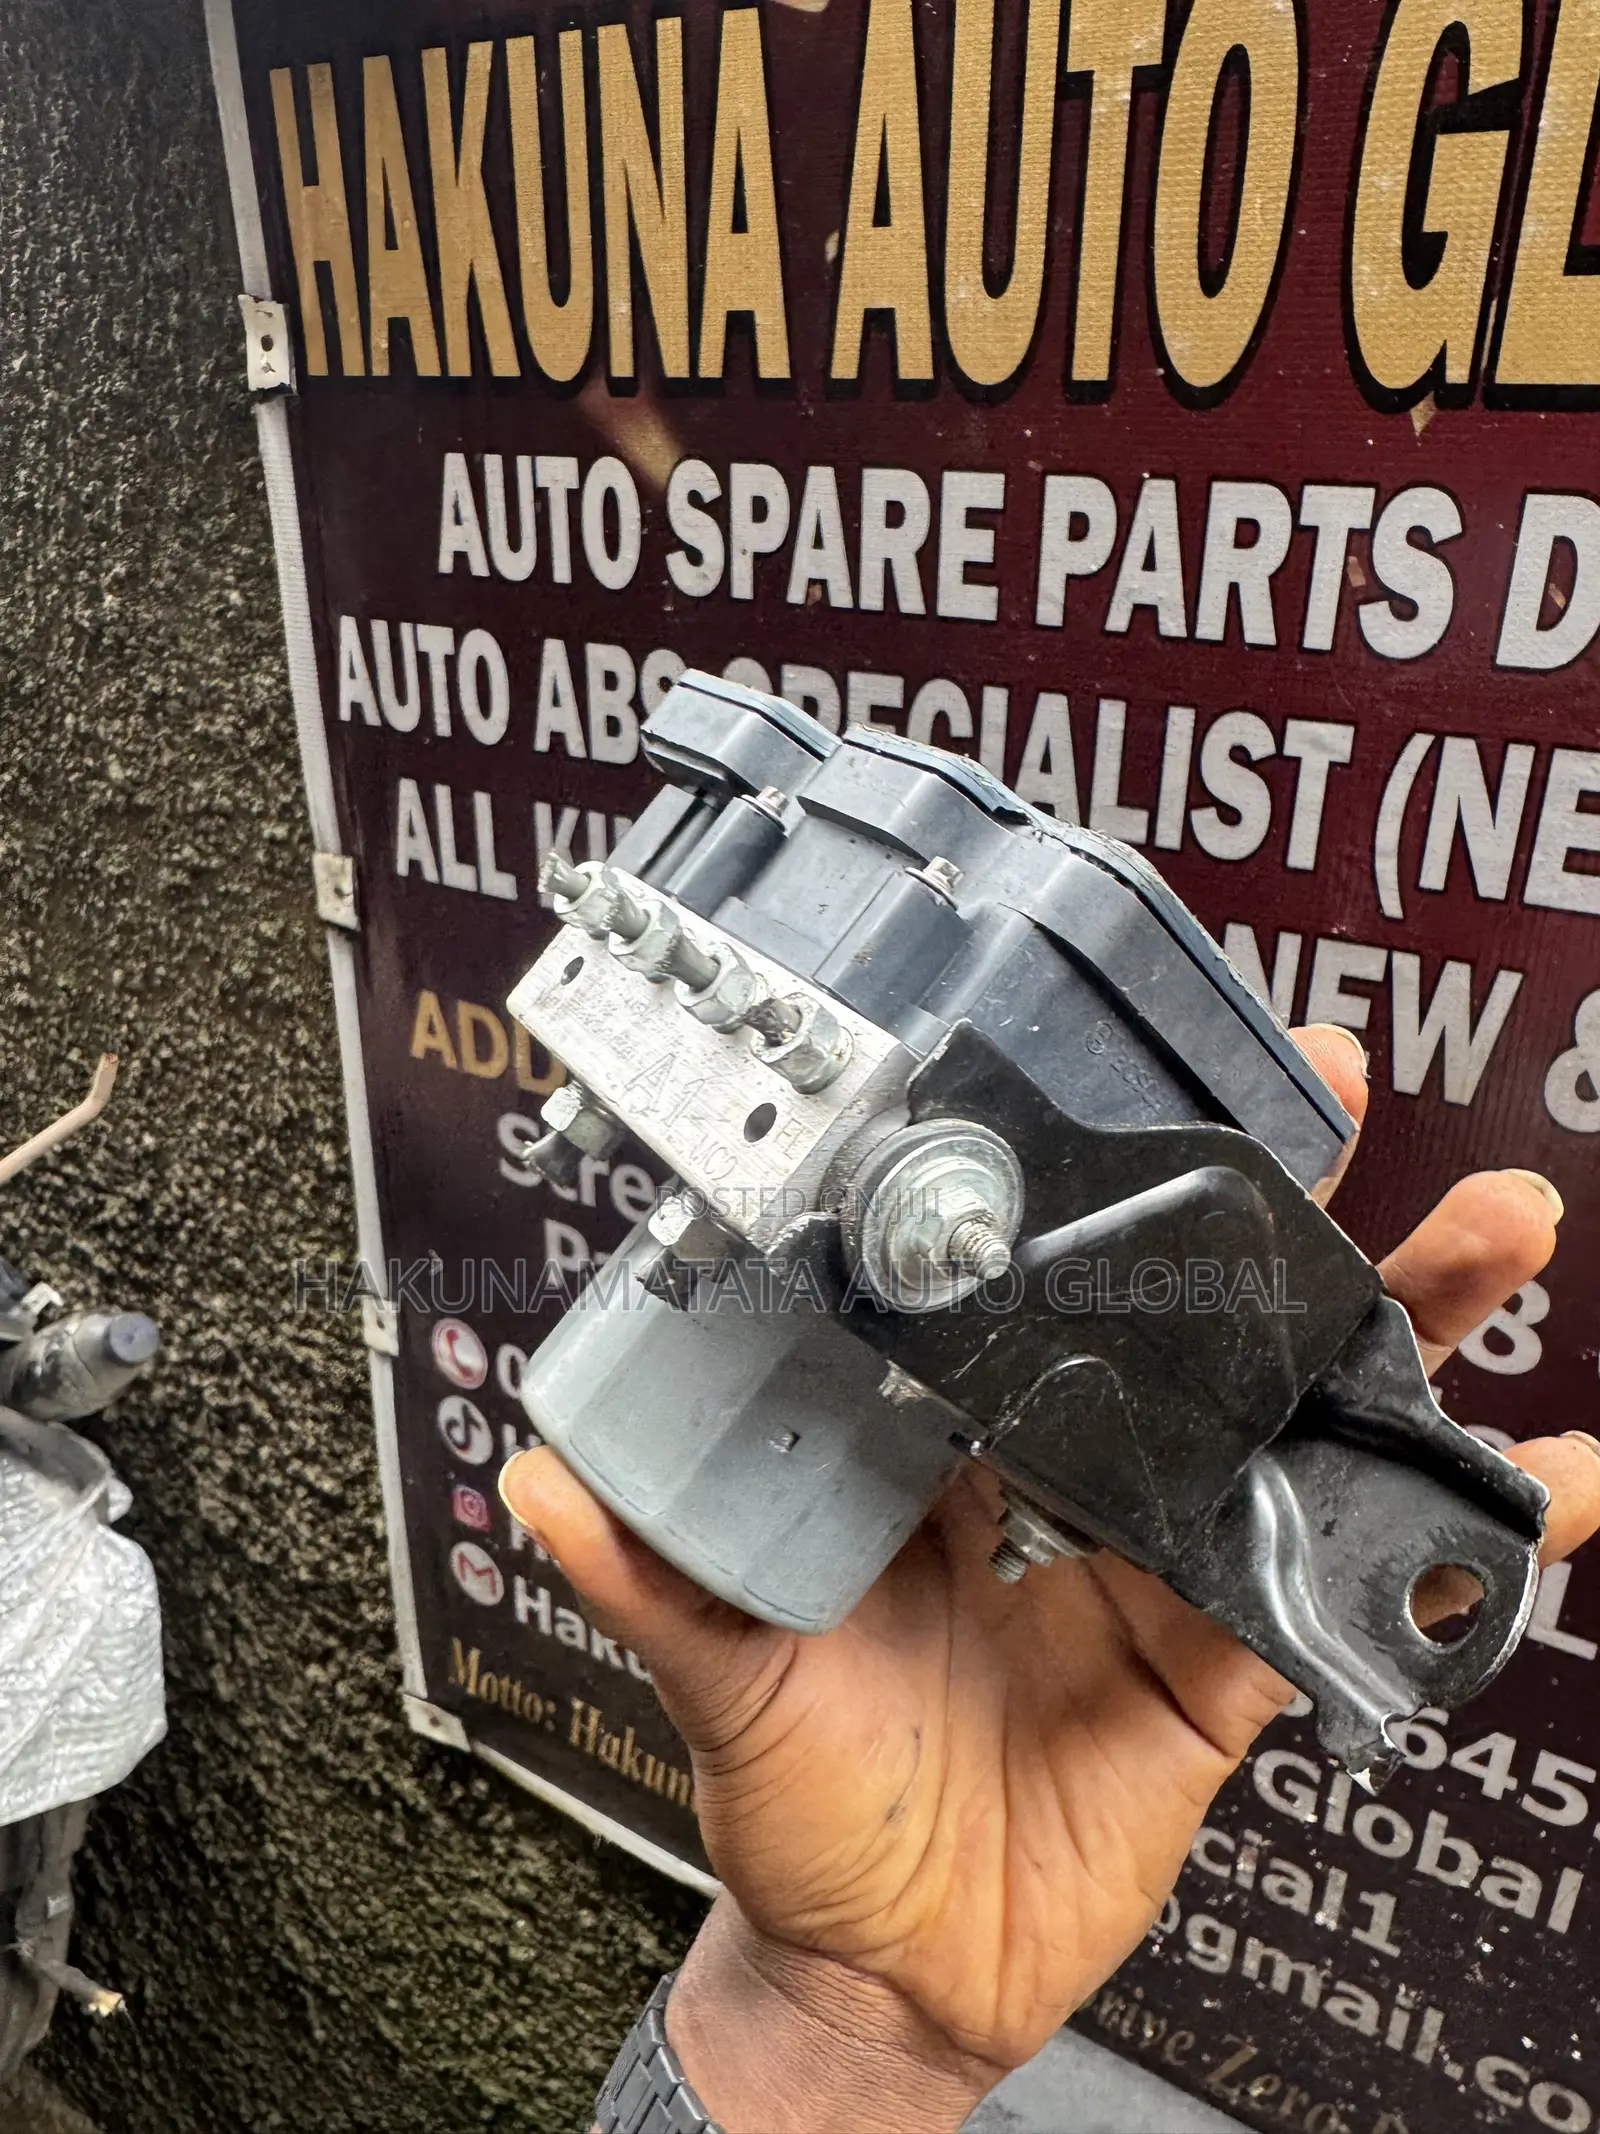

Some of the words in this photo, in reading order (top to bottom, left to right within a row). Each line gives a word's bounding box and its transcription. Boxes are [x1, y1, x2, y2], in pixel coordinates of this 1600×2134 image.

[270, 8, 791, 382] HAKUNA
[830, 0, 1300, 389] AUTO
[438, 452, 641, 590] AUTO
[665, 458, 1006, 623] SPARE
[1035, 474, 1463, 660] PARTS
[339, 615, 509, 746] AUTO
[722, 657, 1355, 872] PCIALIST
[397, 777, 519, 901] ALL
[534, 801, 632, 908] KI
[451, 1636, 557, 1732] Motto:
[1253, 1749, 1585, 1935] Global
